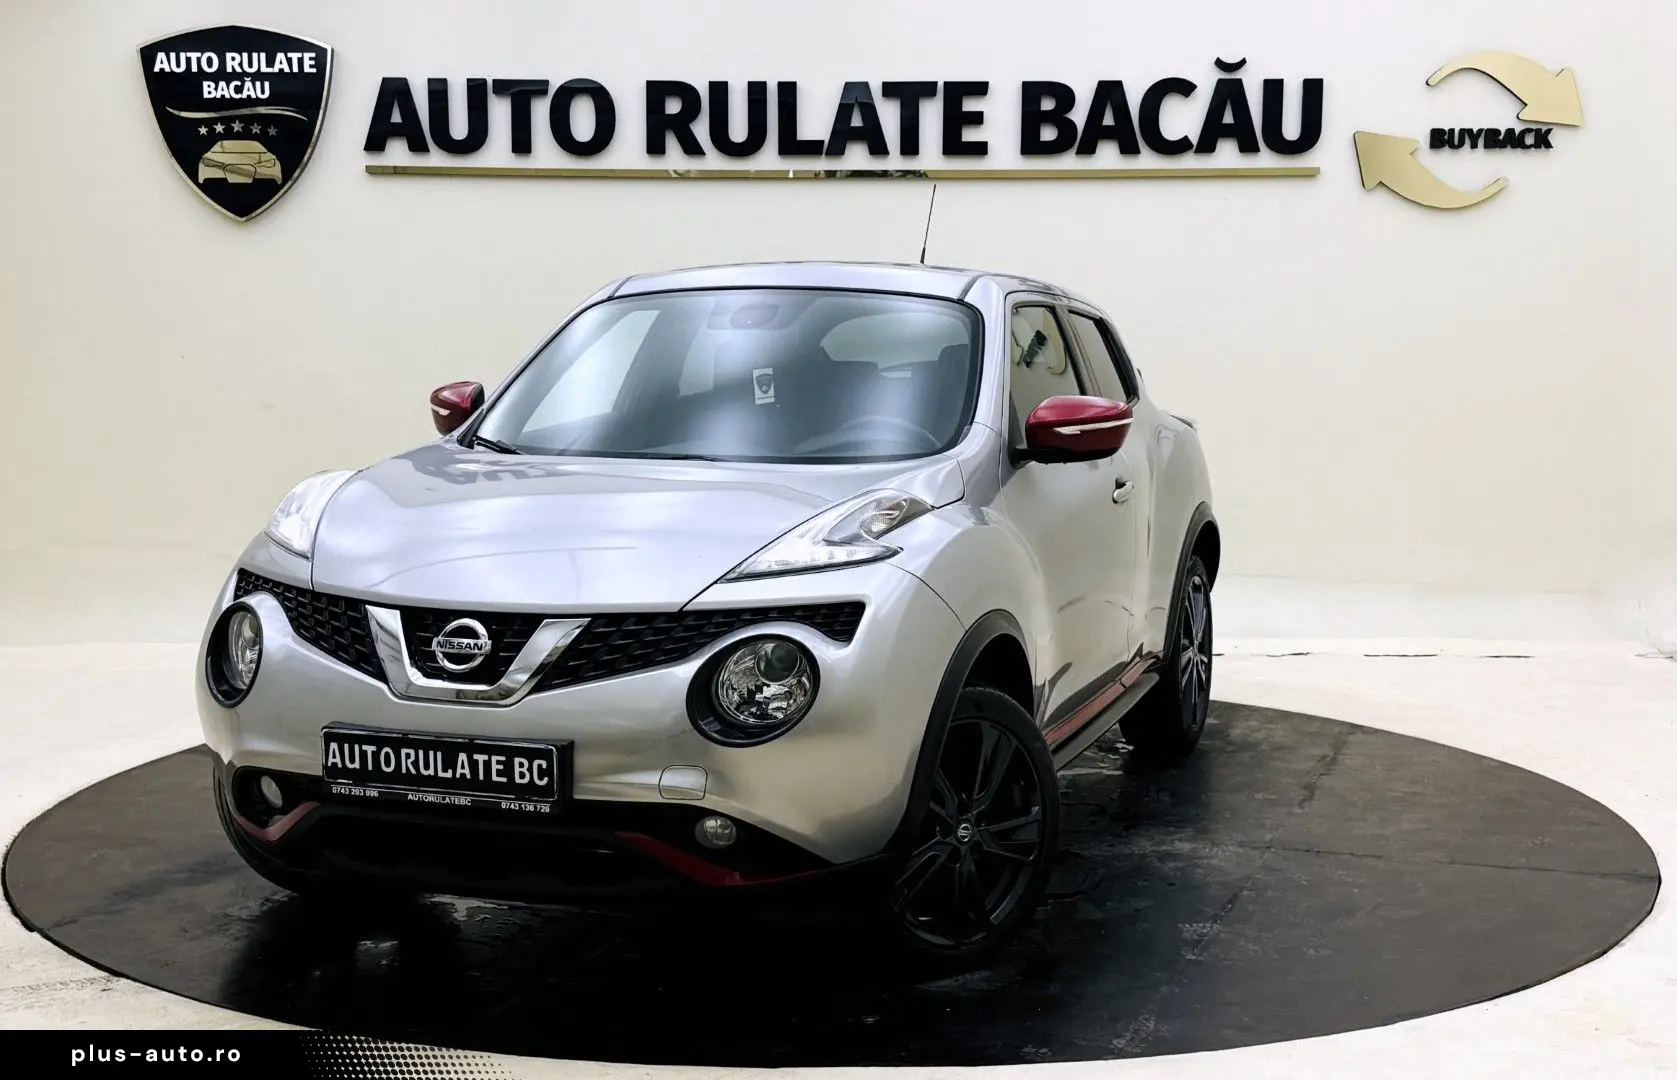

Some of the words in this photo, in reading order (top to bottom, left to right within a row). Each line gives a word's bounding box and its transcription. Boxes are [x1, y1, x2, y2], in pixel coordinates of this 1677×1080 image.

[153, 52, 219, 73] AUTO
[225, 52, 317, 73] RULATE
[202, 77, 270, 99] BACĂU
[363, 77, 617, 157] AUTO
[645, 79, 990, 157] RULATE
[1020, 57, 1324, 156] BACĂU
[1429, 128, 1553, 150] BUYBACK
[436, 640, 484, 651] NISSAN
[328, 742, 396, 774] AUTO
[400, 748, 507, 783] RULATE
[513, 757, 549, 786] BC
[332, 786, 350, 795] 0743
[407, 793, 472, 806] AUTORULATEBC
[501, 801, 519, 810] 0743
